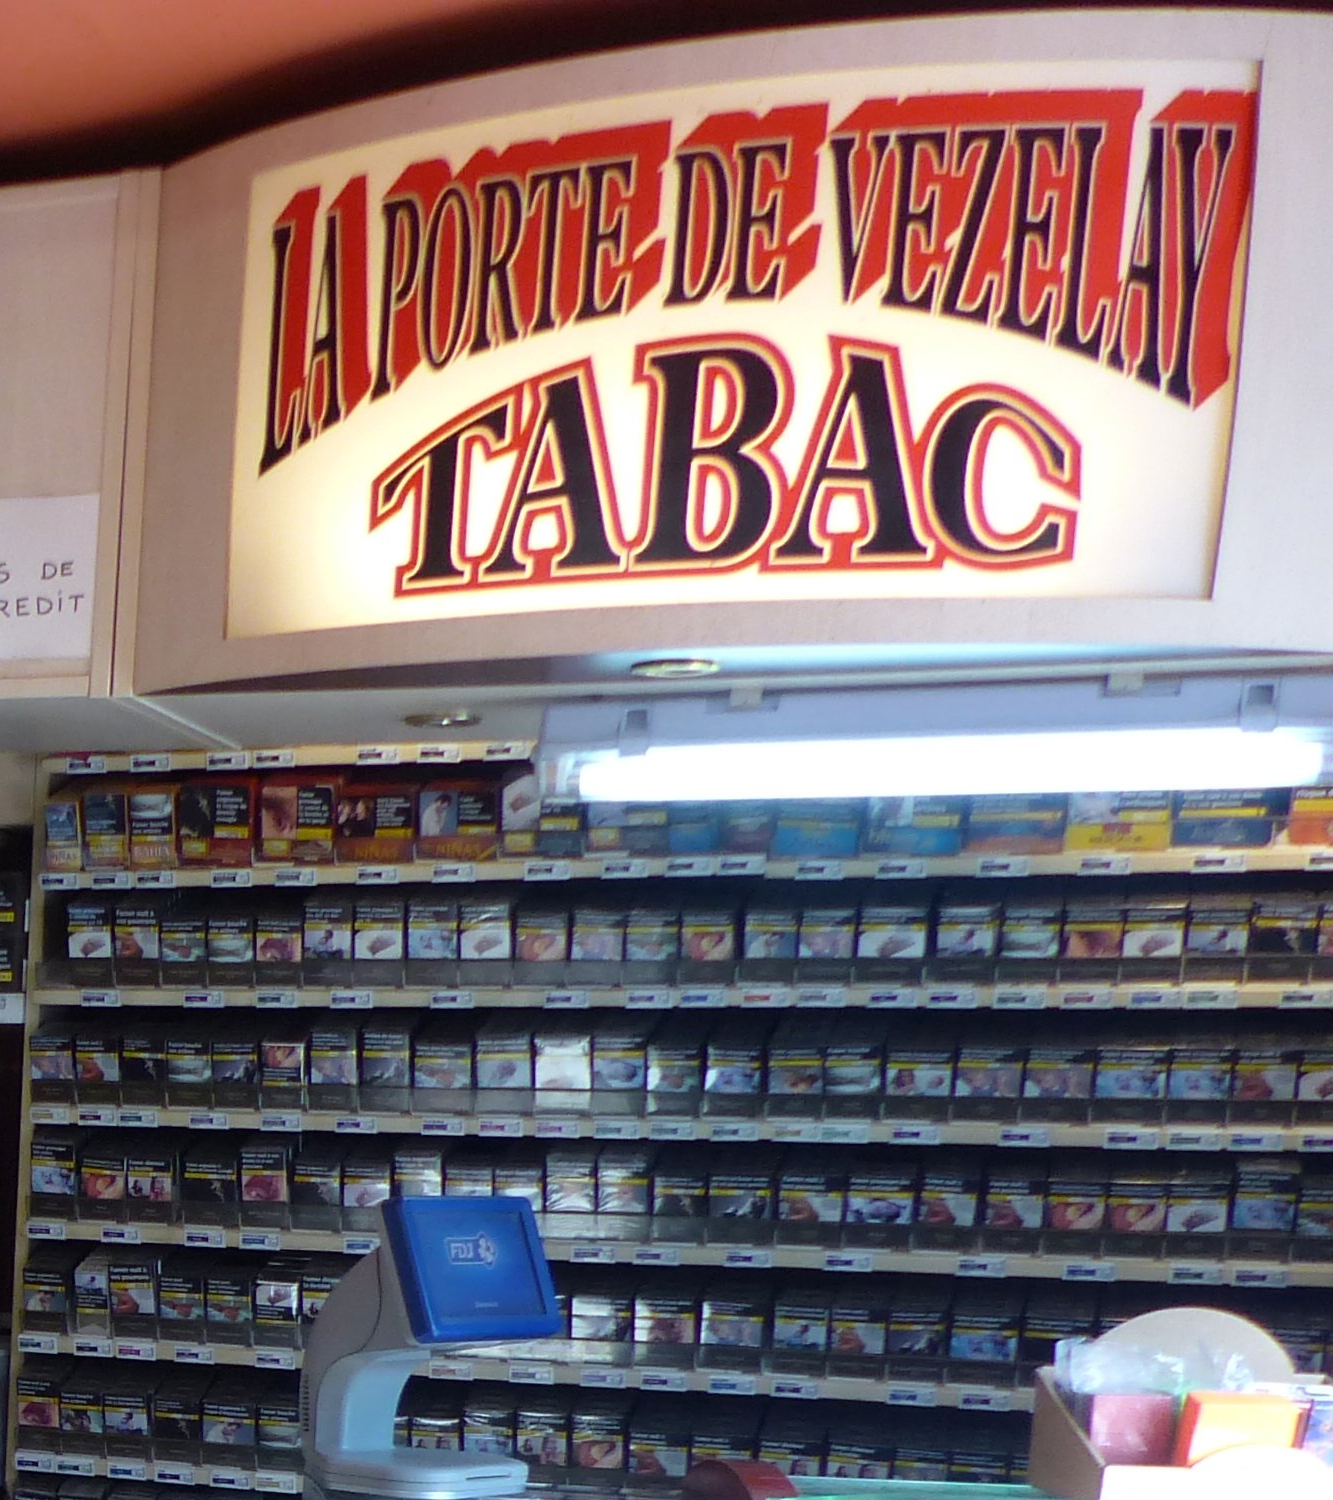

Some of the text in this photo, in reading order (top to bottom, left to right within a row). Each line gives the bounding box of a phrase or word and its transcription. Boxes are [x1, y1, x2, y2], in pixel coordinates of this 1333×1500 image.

[259, 90, 1258, 478] LA PORTE DE VEZELAY
[367, 335, 1081, 597] TABAC
[40, 560, 75, 580] DE
[449, 1242, 475, 1259] FDJ
